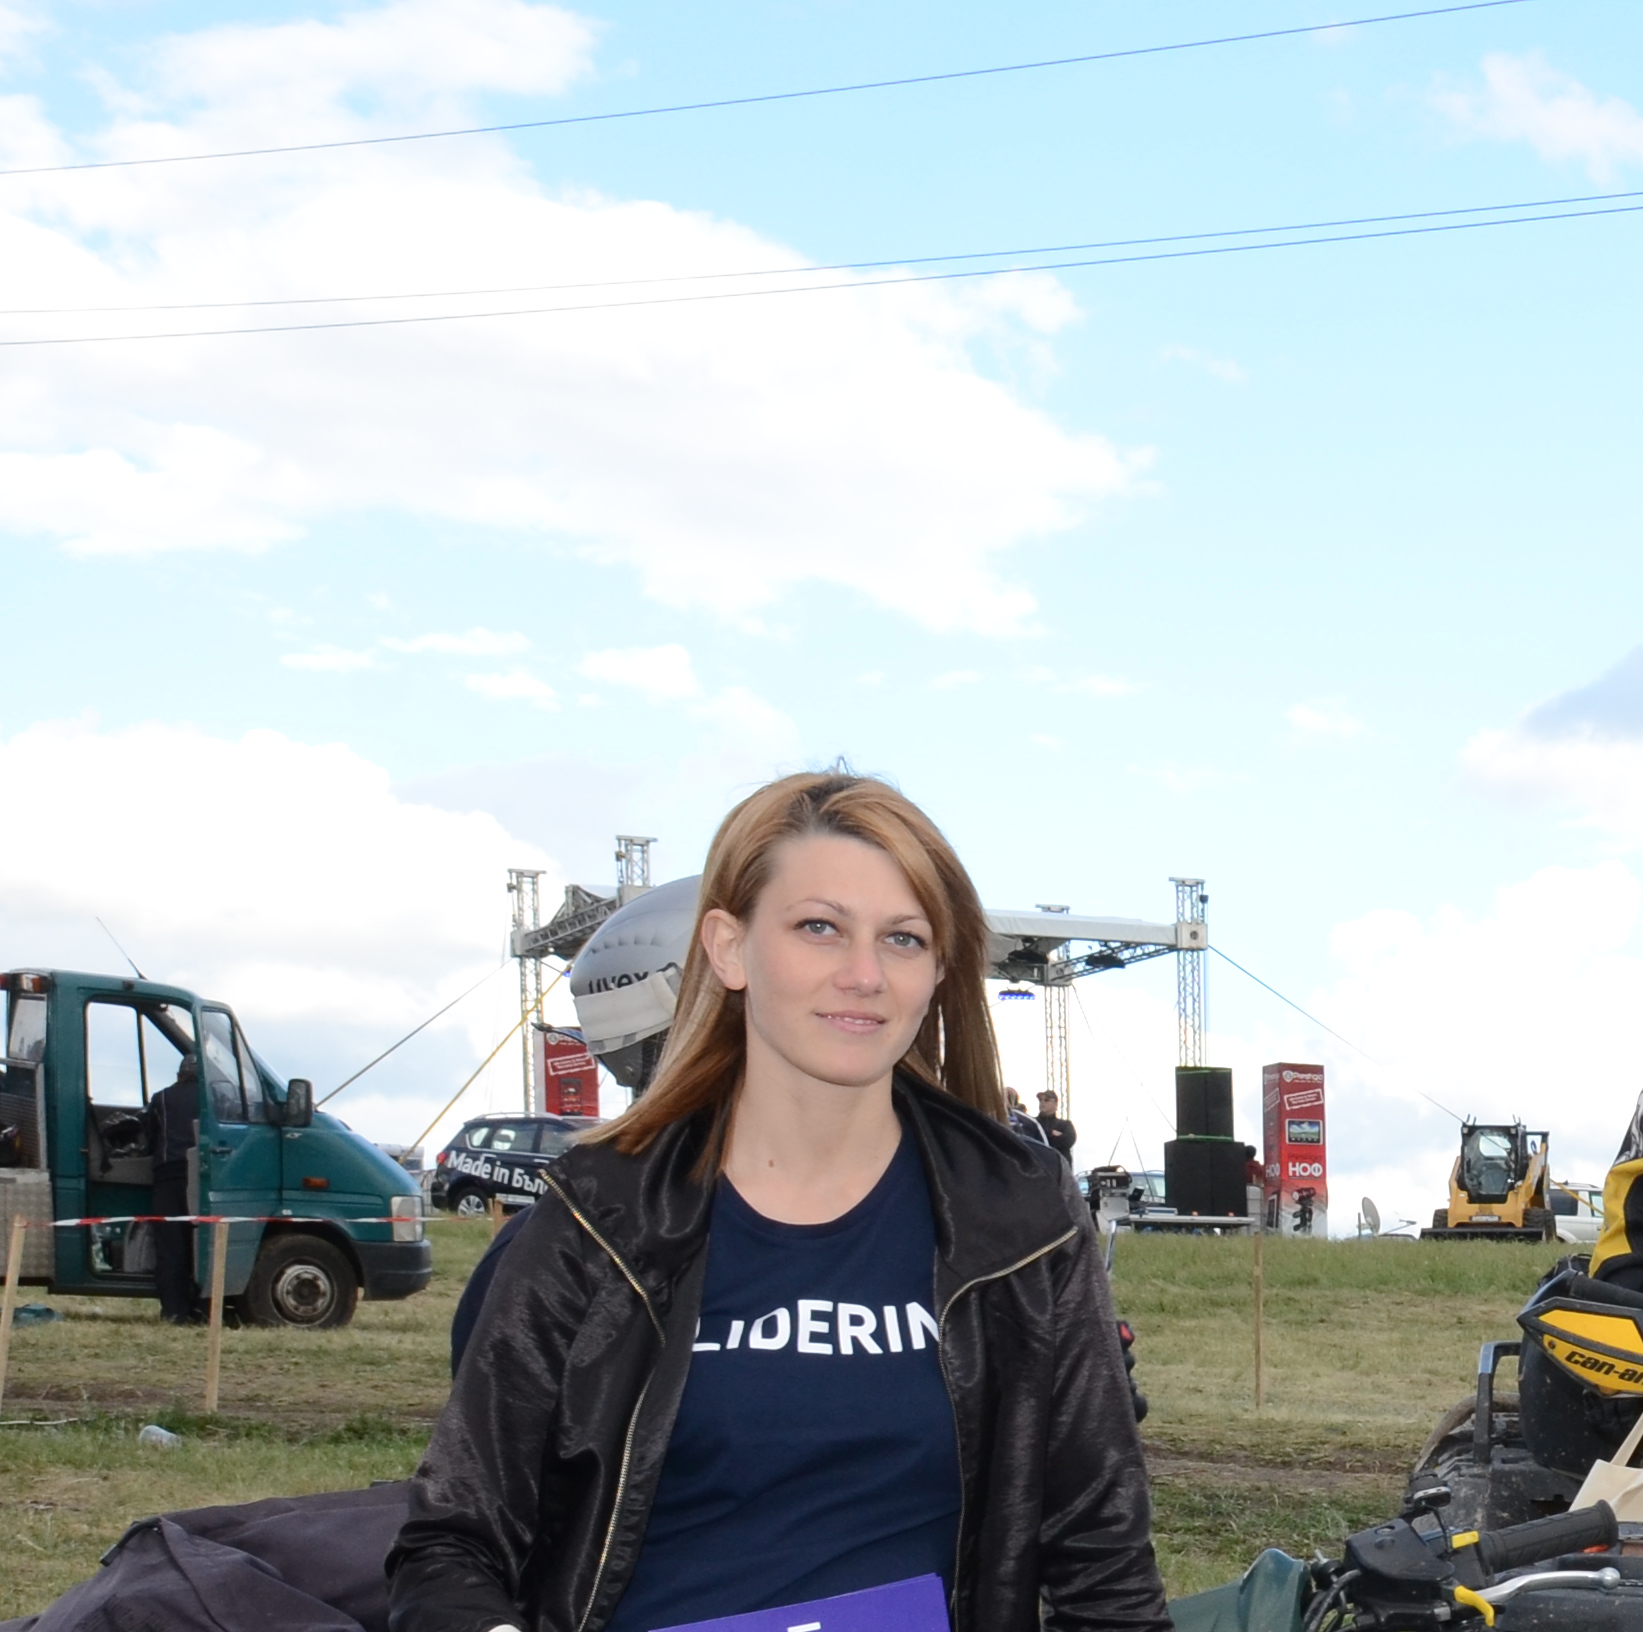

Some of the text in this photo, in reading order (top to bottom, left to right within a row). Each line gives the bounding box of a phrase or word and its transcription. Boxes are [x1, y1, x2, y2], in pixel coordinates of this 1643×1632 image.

[447, 1150, 549, 1195] Made in Бъл
